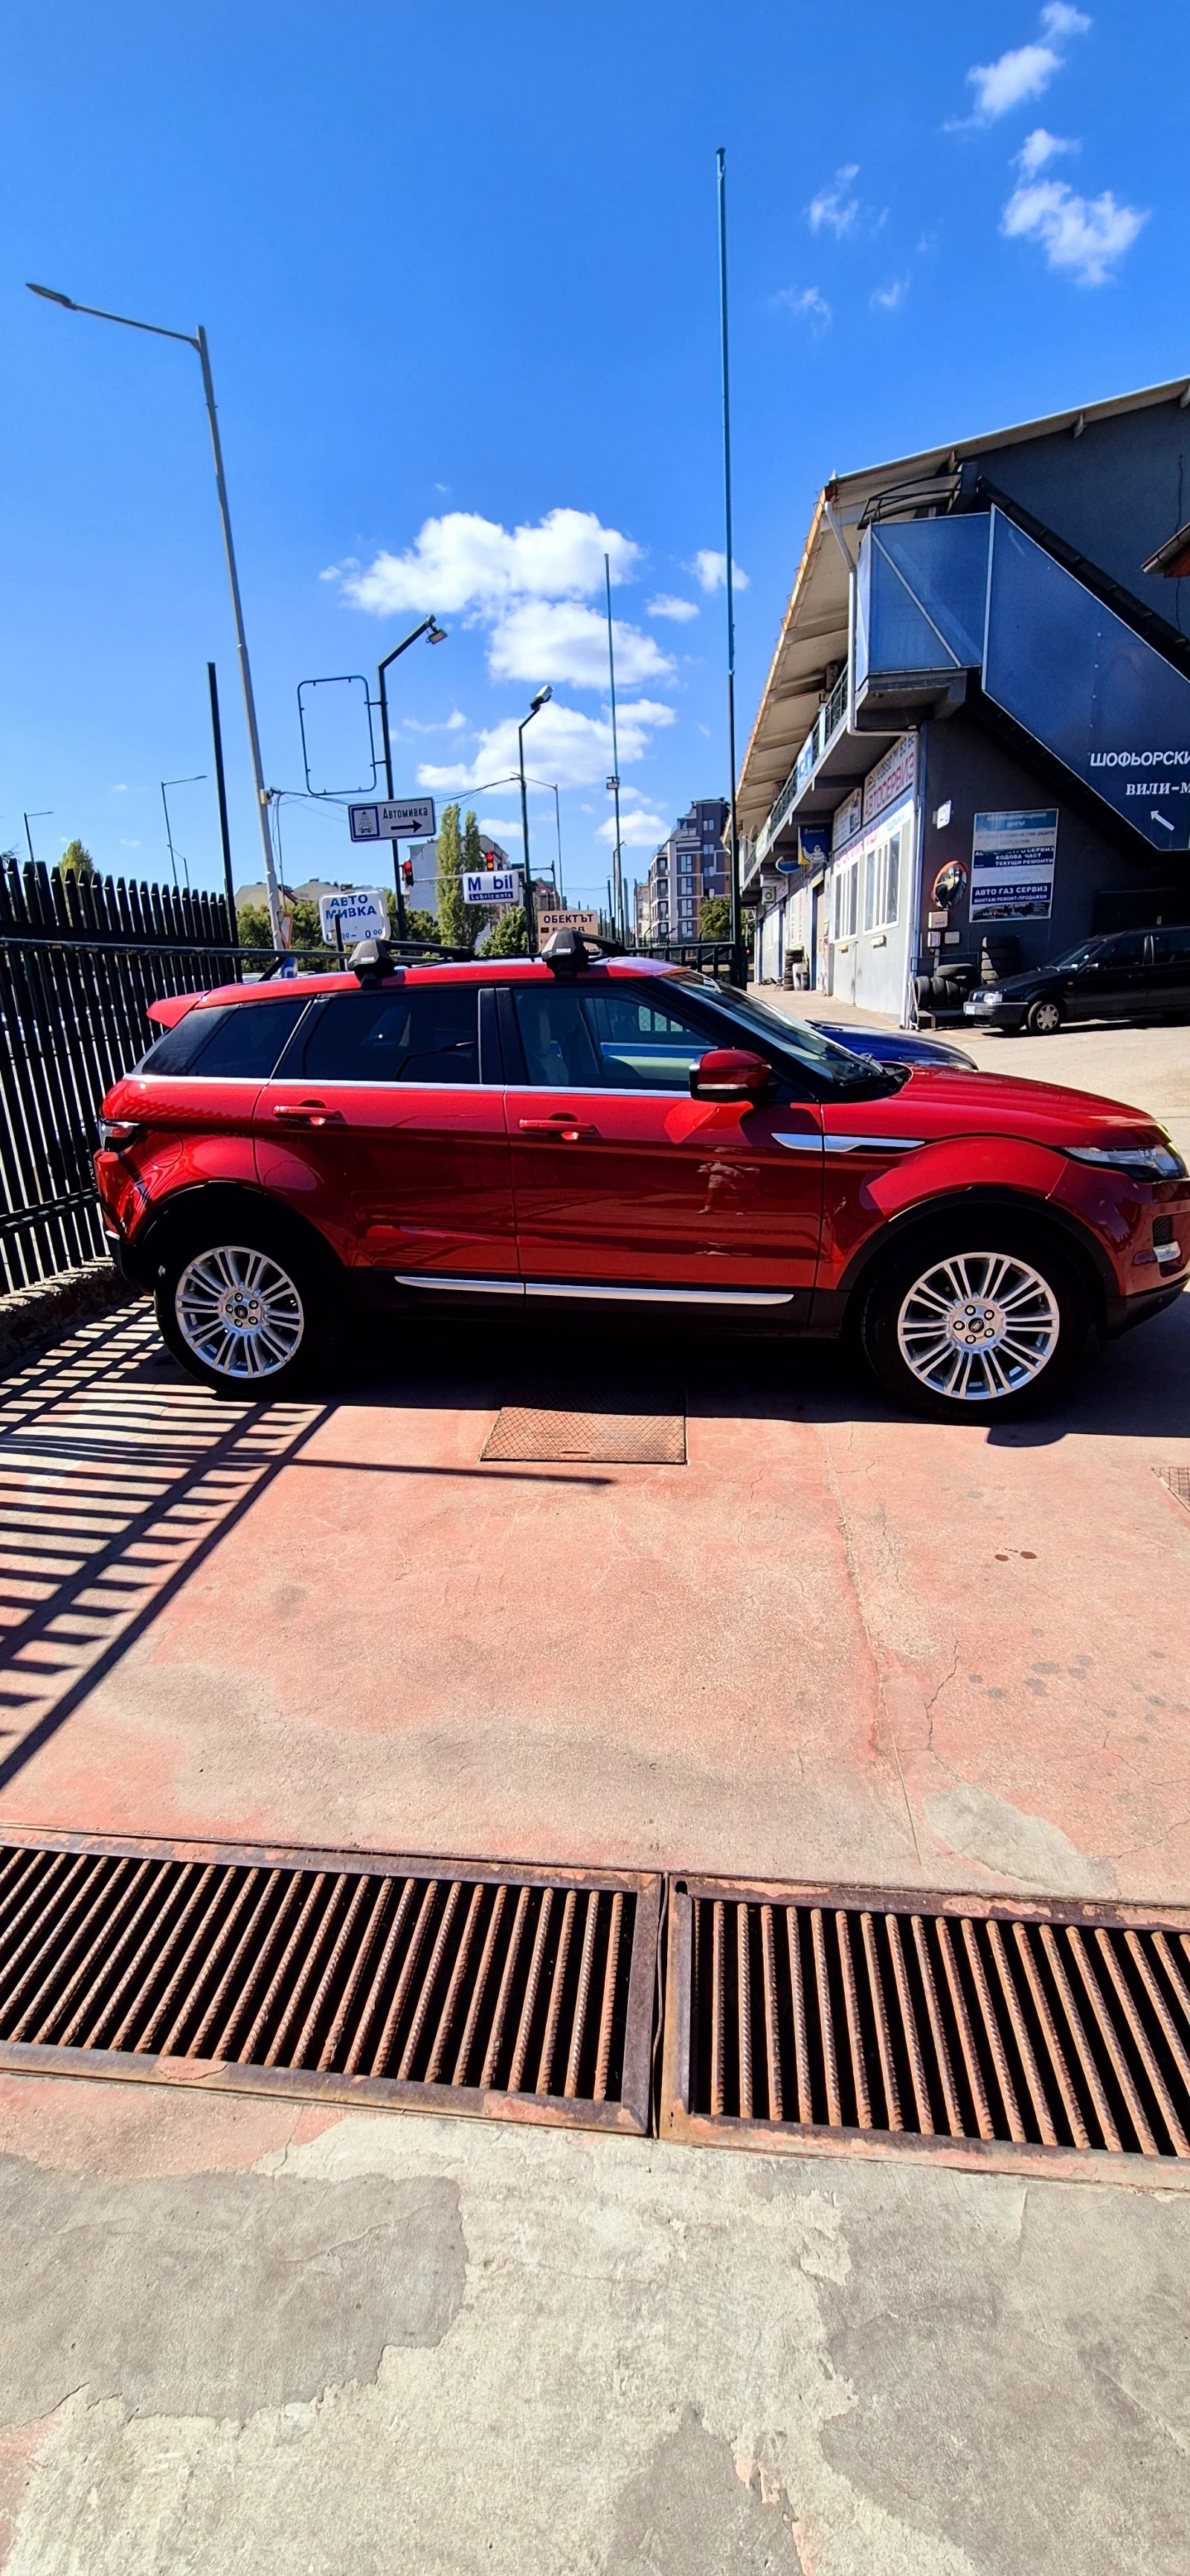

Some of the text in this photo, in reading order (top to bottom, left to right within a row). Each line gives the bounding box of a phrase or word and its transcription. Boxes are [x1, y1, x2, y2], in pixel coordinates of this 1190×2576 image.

[865, 751, 915, 817] АВТОСЕРВИЗ
[1125, 782, 1190, 795] ВИЛИ-М
[383, 807, 428, 819] Автомивка
[468, 875, 513, 891] Mbil
[1016, 885, 1048, 893] СЕРВИЗ
[329, 894, 368, 907] АВТО
[325, 905, 377, 919] МИВКА
[544, 913, 594, 923] ОБЕКТЪТ
